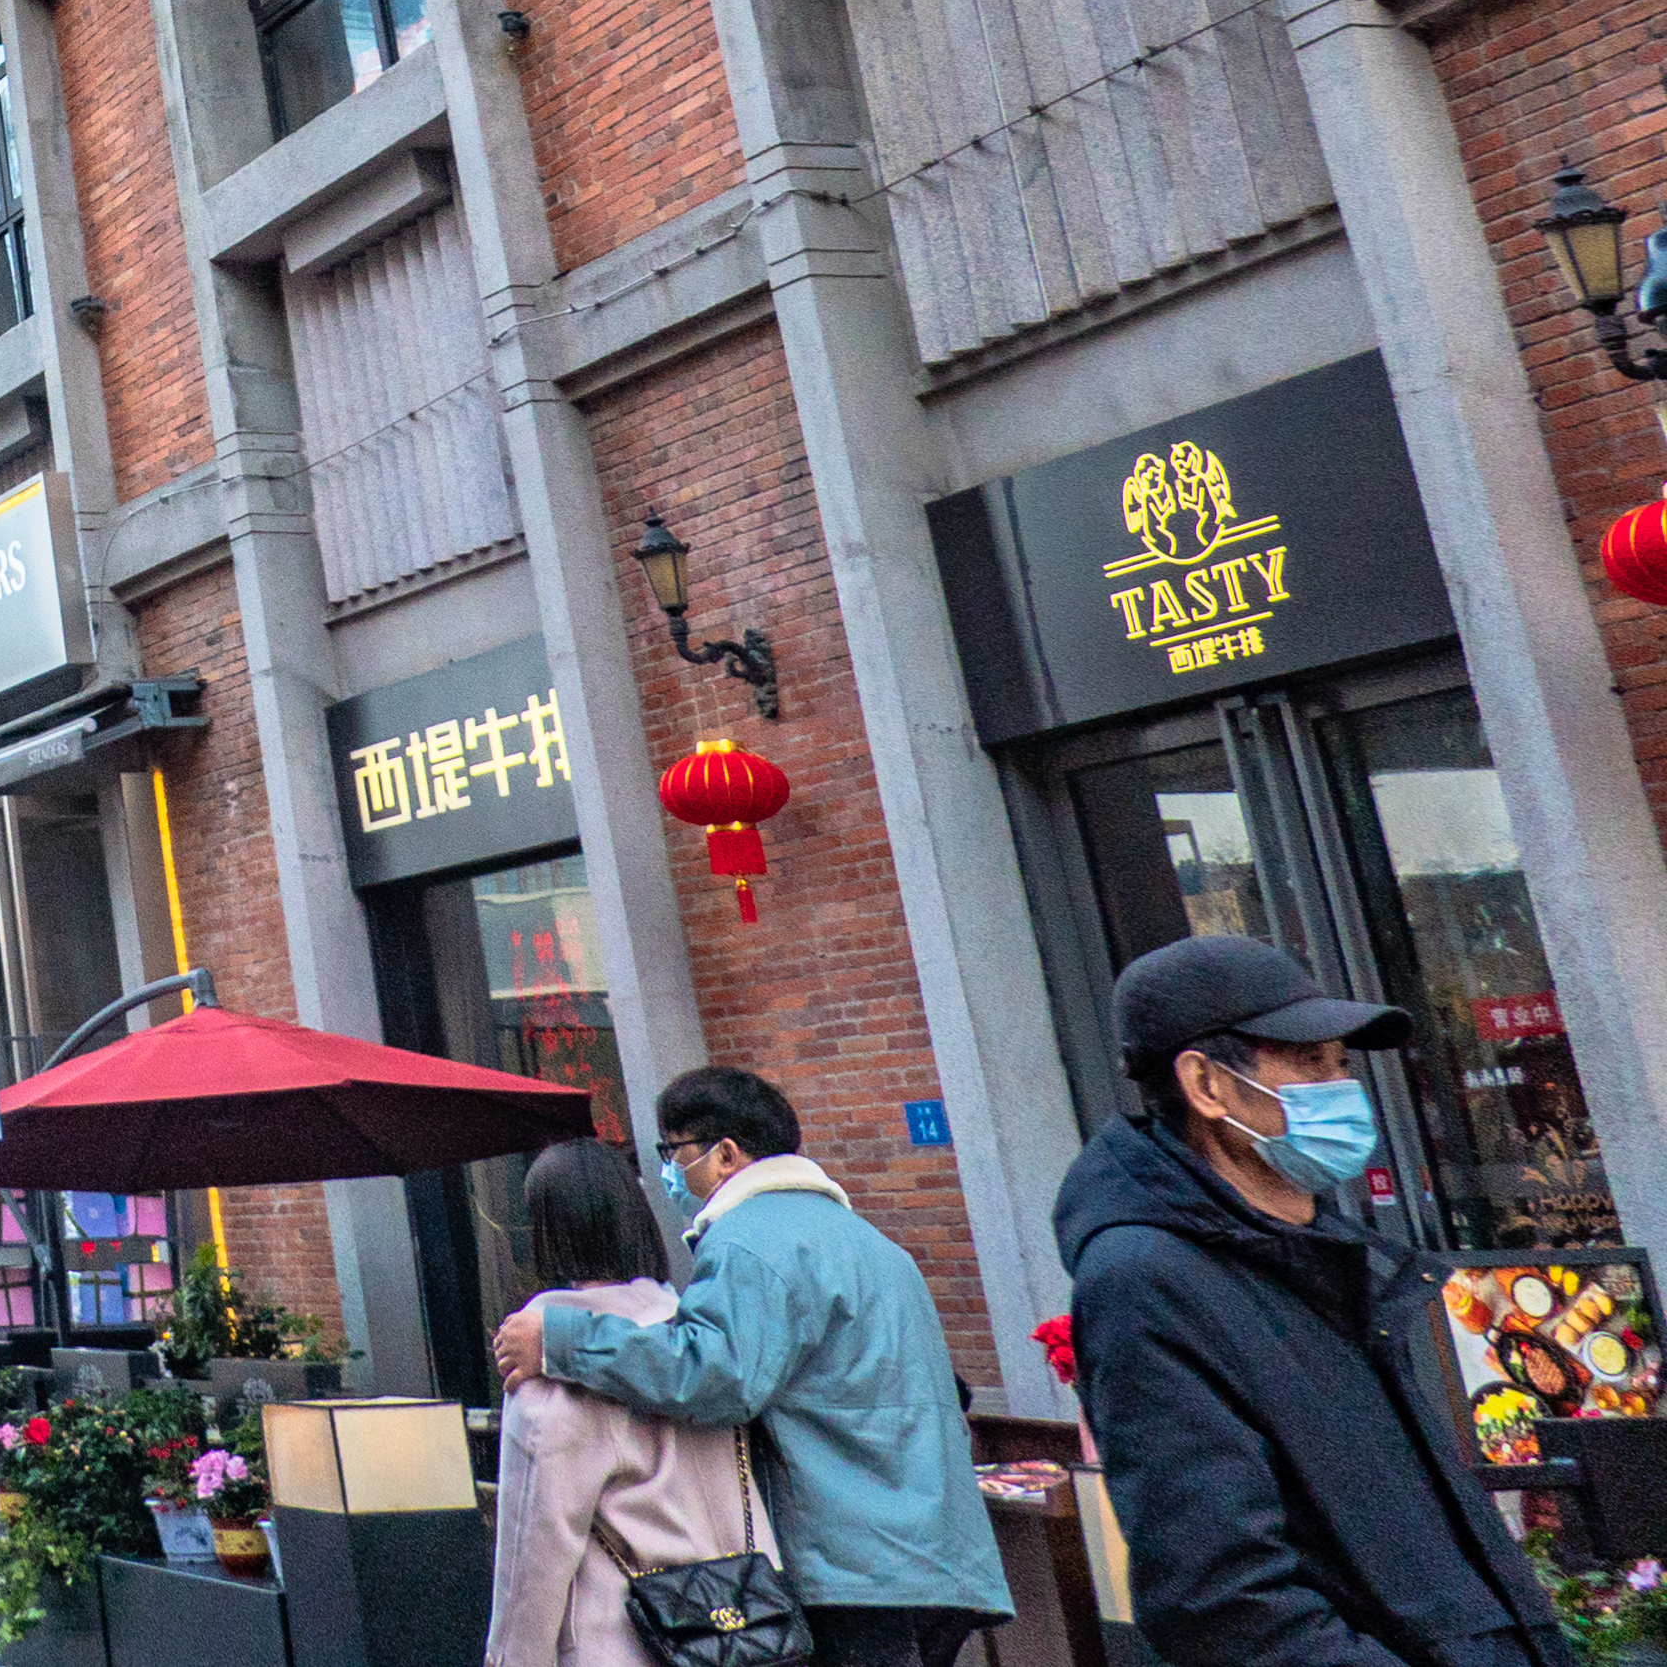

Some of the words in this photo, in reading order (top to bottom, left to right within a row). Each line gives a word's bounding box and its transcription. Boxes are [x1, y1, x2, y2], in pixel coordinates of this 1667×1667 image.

[1109, 545, 1291, 639] TASTY
[1166, 627, 1266, 675] 西堤牛排
[918, 1120, 939, 1140] 14
